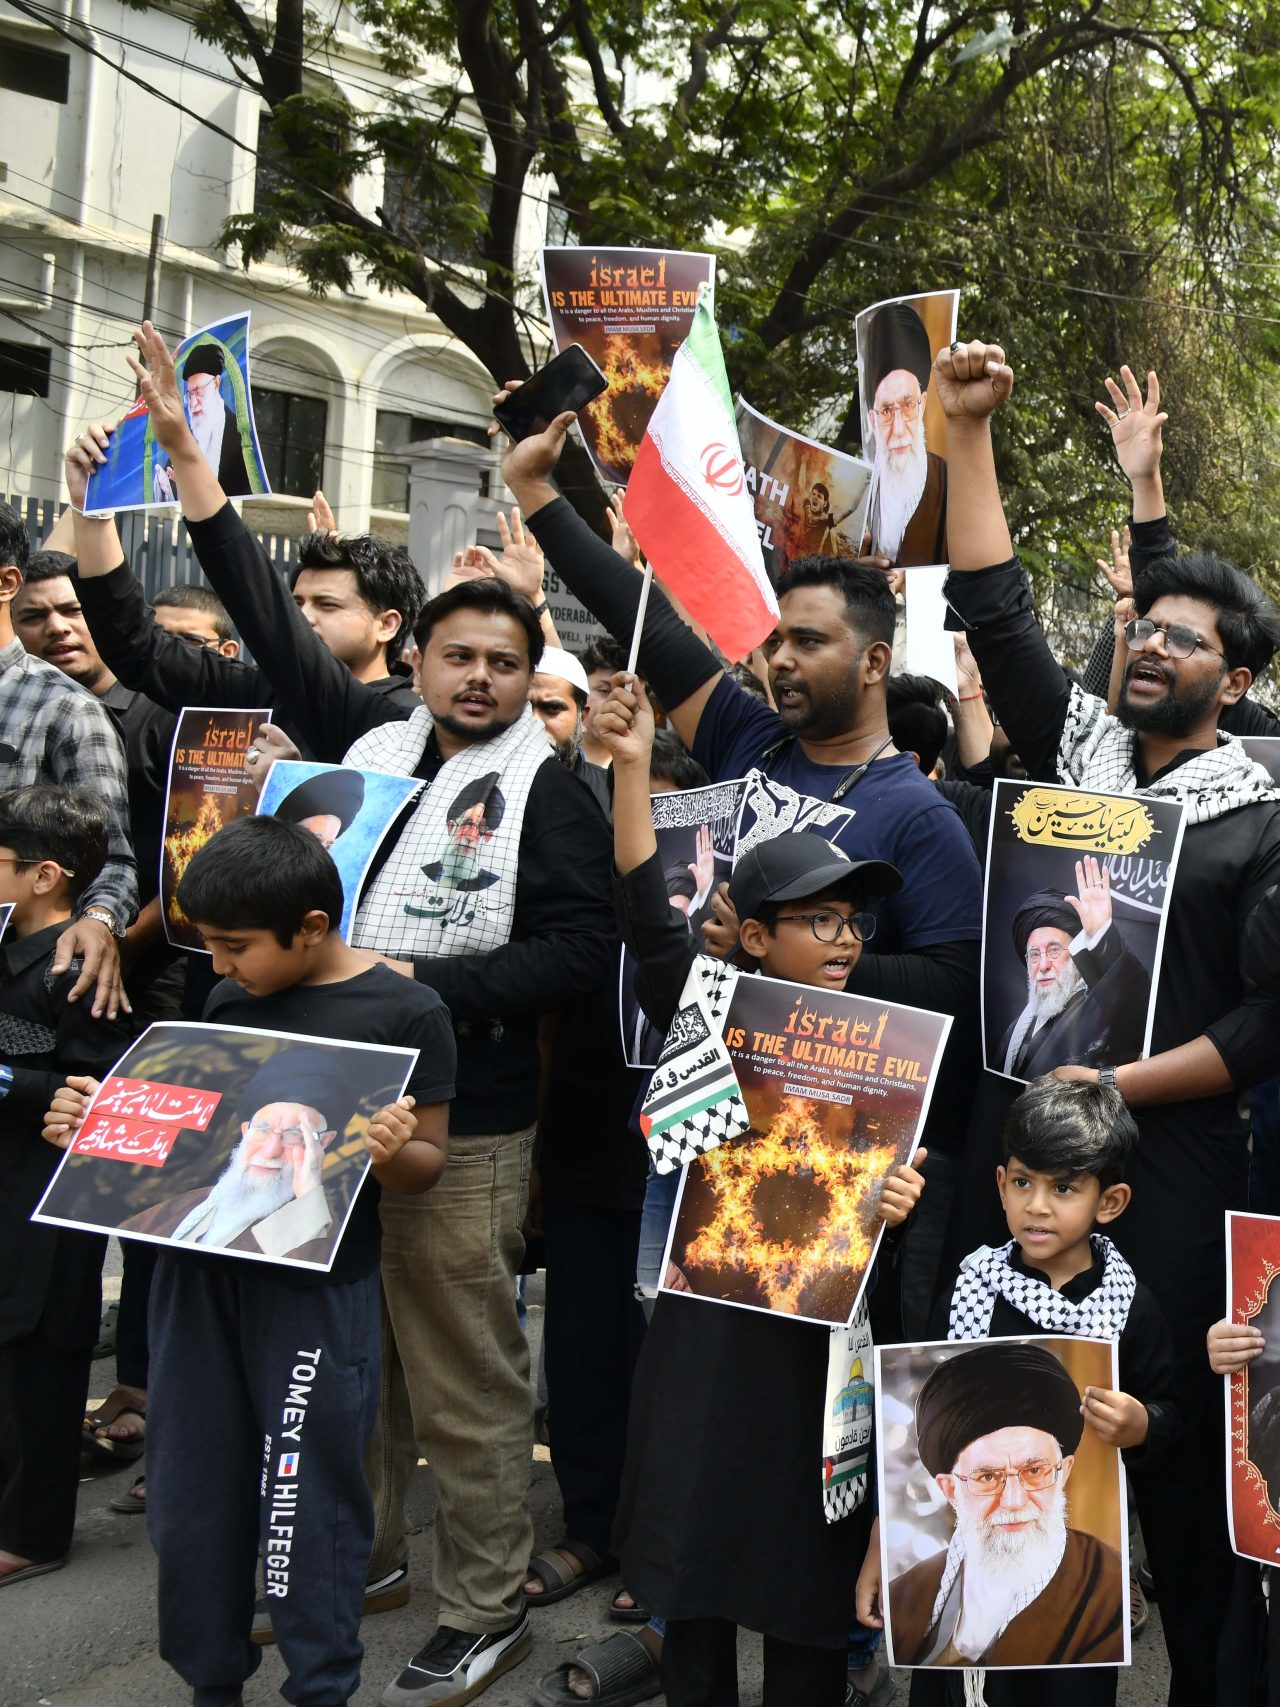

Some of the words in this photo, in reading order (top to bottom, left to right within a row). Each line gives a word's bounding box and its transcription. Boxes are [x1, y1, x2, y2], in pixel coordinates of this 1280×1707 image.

[552, 291, 565, 306] IS
[569, 291, 595, 306] THE
[600, 290, 667, 306] ULTIMATE
[672, 291, 700, 306] EVI
[176, 748, 185, 763] IS
[188, 750, 205, 765] THE
[208, 750, 246, 767] ULTIMAT
[783, 995, 890, 1050] israel
[679, 1047, 721, 1081] القدس
[726, 1027, 746, 1048] IS
[752, 1032, 787, 1056] THE
[791, 1040, 879, 1073] ULTIMATE
[883, 1056, 928, 1083] EVIL.
[752, 1054, 776, 1064] danger
[786, 1060, 796, 1068] all
[796, 1062, 808, 1070] the
[810, 1064, 832, 1076] Arabs,
[834, 1068, 864, 1080] Muslims
[864, 1075, 879, 1084] and
[880, 1078, 916, 1091] Christians,
[762, 1068, 786, 1078] peace,
[788, 1070, 820, 1084] freedom,
[821, 1078, 834, 1086] and
[836, 1080, 862, 1091] human
[862, 1086, 889, 1098] dignity.
[784, 1084, 808, 1095] IMAM
[808, 1088, 830, 1100] MUSA
[831, 1094, 852, 1103] SADR
[281, 1348, 322, 1442] TOMEY
[266, 1483, 299, 1599] HILFEGER
